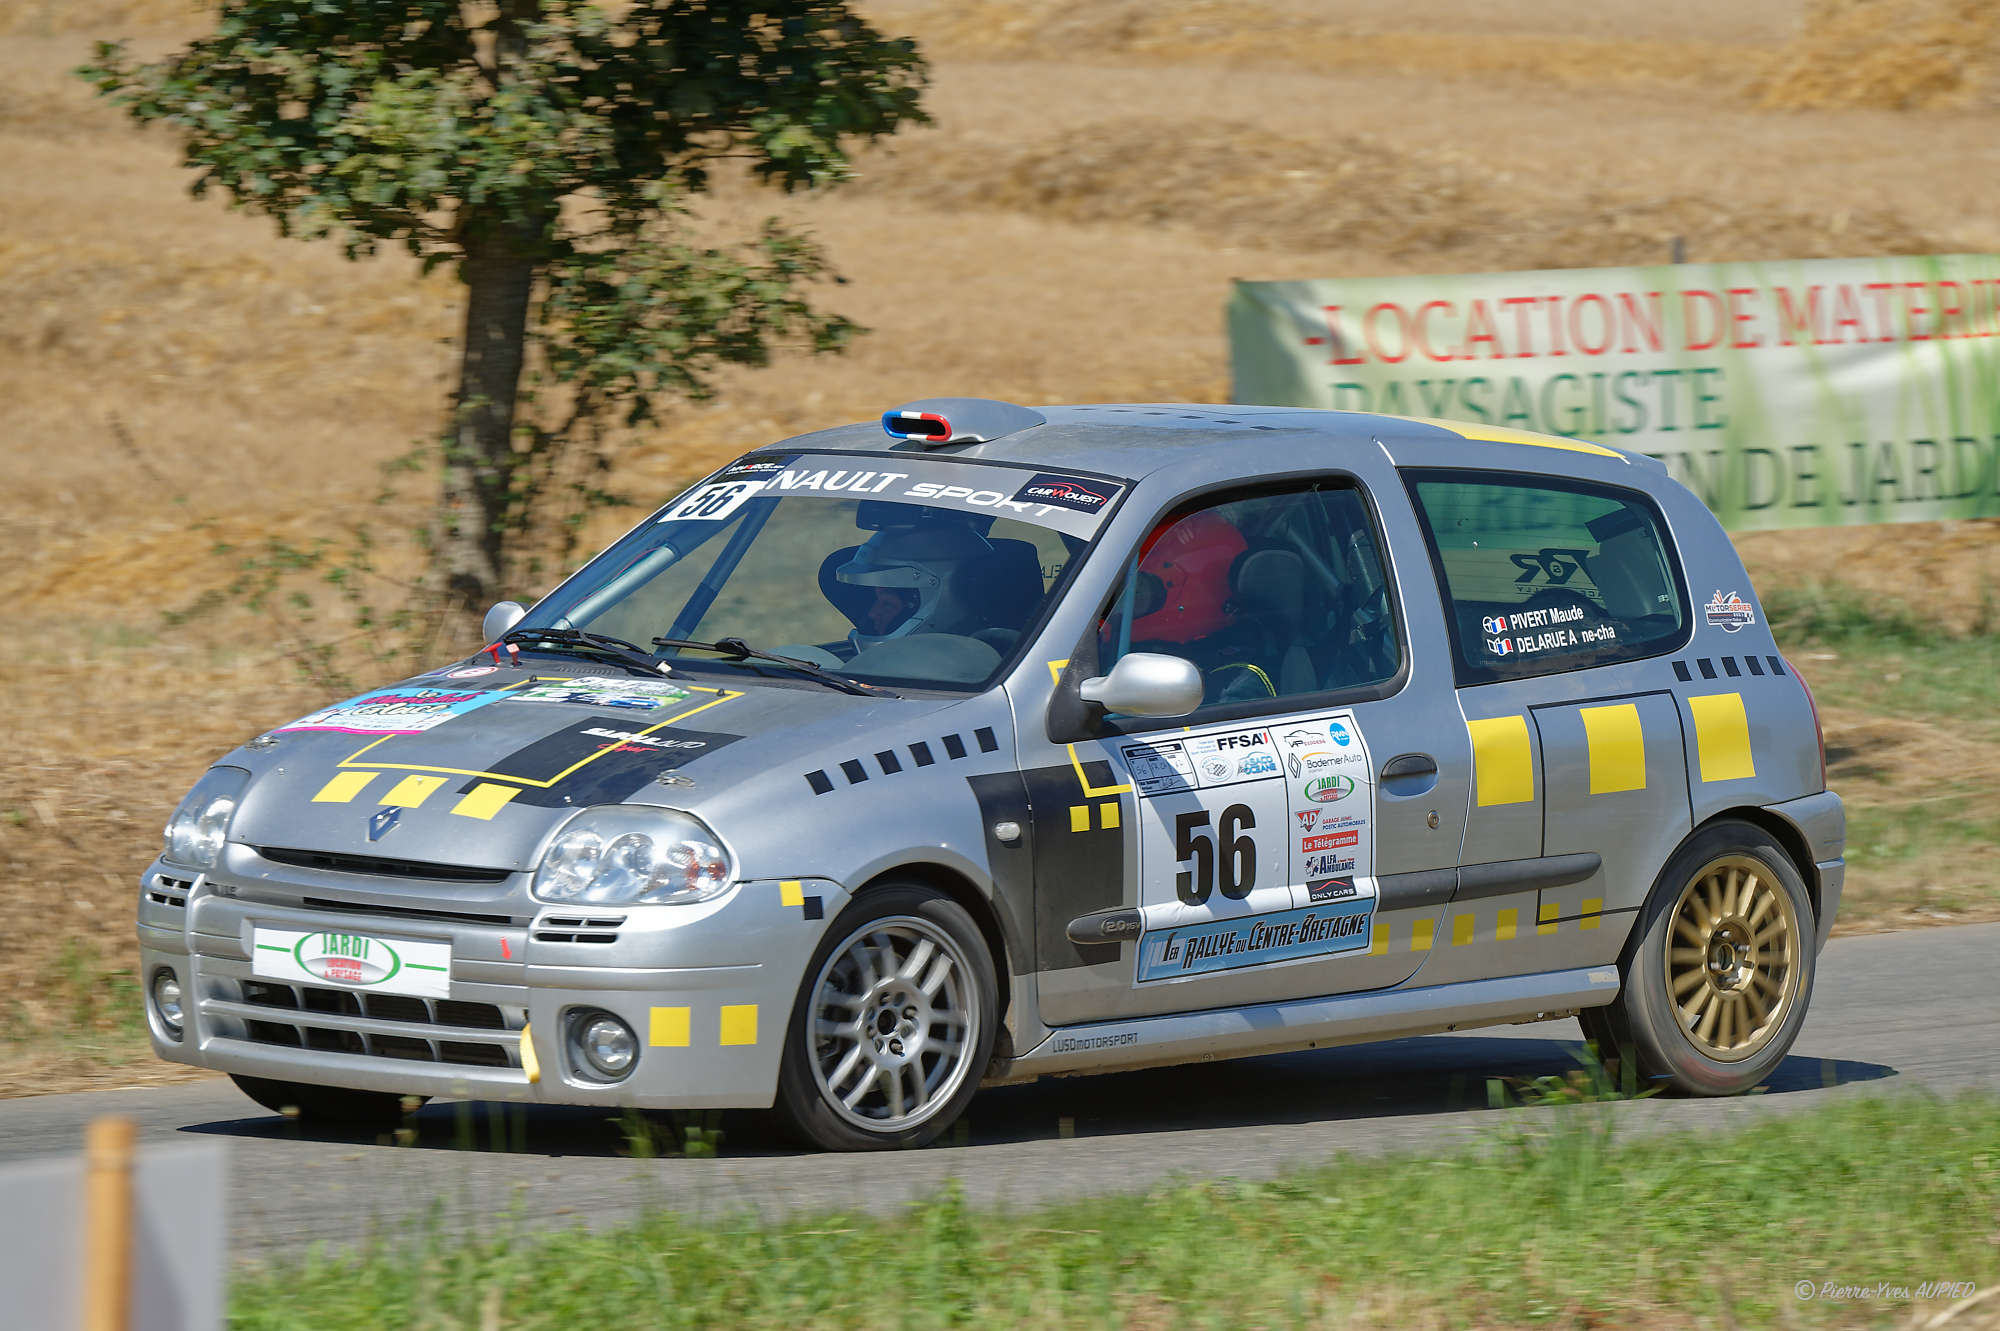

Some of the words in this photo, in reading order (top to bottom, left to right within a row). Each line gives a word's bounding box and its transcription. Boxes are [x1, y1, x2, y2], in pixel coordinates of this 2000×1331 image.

[1680, 288, 1763, 350] DE
[1741, 446, 1821, 510] DE
[677, 484, 747, 518] 56
[1509, 609, 1548, 631] PIVERT
[1549, 604, 1584, 625] Maude
[1516, 630, 1568, 653] DELARUE
[1216, 732, 1264, 751] FFSA
[1317, 776, 1340, 790] JARDI
[1302, 812, 1317, 826] AD
[1175, 803, 1256, 907] 56
[1304, 841, 1312, 851] Le
[1314, 835, 1358, 850] Télégramme
[1311, 891, 1332, 900] ONLY
[1333, 888, 1354, 897] CARS
[321, 933, 369, 960] JARDI
[1182, 931, 1237, 969] RALLYE
[1235, 938, 1247, 947] DU
[1247, 911, 1368, 951] CENTRE-BRETAGNE
